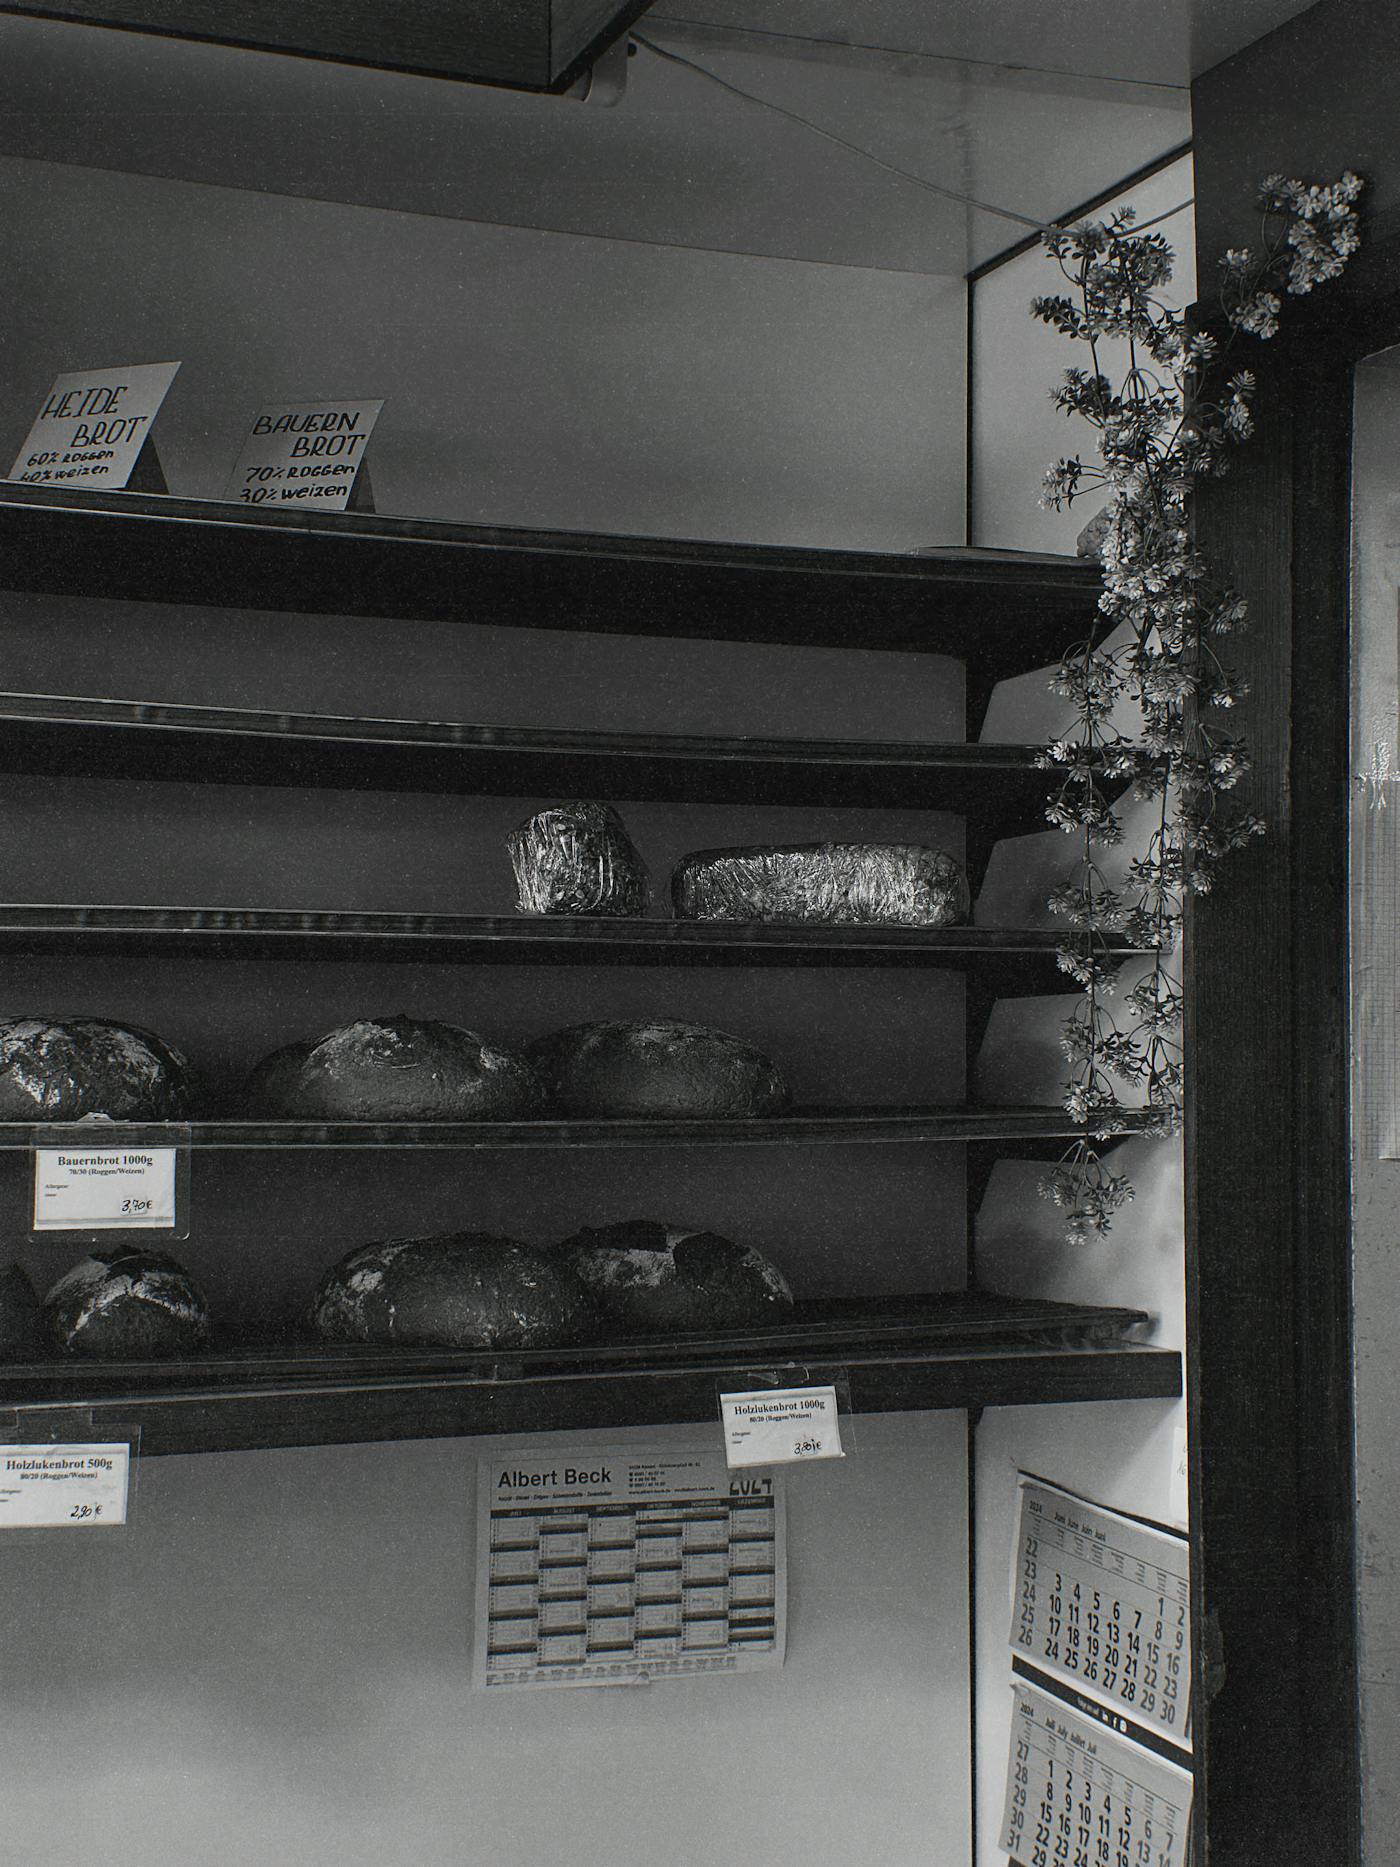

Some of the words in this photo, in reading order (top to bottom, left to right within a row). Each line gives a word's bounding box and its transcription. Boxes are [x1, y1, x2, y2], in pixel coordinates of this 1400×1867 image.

[41, 386, 128, 420] HEIDE
[70, 416, 149, 448] BROT
[252, 412, 360, 435] BAUERN
[290, 434, 366, 458] BROT
[27, 452, 59, 467] 60%
[246, 466, 285, 483] 70%
[240, 487, 277, 503] 30%
[58, 1155, 119, 1166] Bauernbrot
[123, 1155, 153, 1167] 1000g
[88, 1167, 145, 1176] (Roggen/Weizen)
[734, 1401, 797, 1415] Holzlukenbrot
[800, 1399, 825, 1410] 1000g
[6, 1459, 84, 1470] Holzlukenbrot
[87, 1458, 113, 1470] 500g
[40, 1472, 98, 1480] (Roggen/Weizen)
[498, 1470, 557, 1488] Albert
[565, 1467, 611, 1485] Beck
[1026, 1537, 1037, 1558] 22
[1158, 1597, 1164, 1616] 1
[1178, 1607, 1184, 1626] 2
[1025, 1560, 1036, 1579] 23
[1056, 1573, 1061, 1592] 3
[1074, 1584, 1080, 1602] 4
[1094, 1592, 1100, 1610] 5
[1113, 1601, 1120, 1620] 6
[1134, 1610, 1142, 1629] 7
[1155, 1621, 1162, 1640] 8
[1175, 1631, 1183, 1650] 9
[1024, 1581, 1036, 1602] 24
[1049, 1594, 1061, 1614] 10
[1069, 1603, 1079, 1624] 11
[1088, 1613, 1099, 1634] 12
[1107, 1622, 1120, 1643] 13
[1128, 1632, 1140, 1654] 14
[1147, 1642, 1160, 1664] 15
[1167, 1653, 1180, 1675] 16
[1022, 1603, 1034, 1624] 25
[1049, 1616, 1060, 1636] 17
[1068, 1626, 1079, 1647] 18
[1087, 1636, 1099, 1657] 19
[1105, 1644, 1119, 1667] 20
[1124, 1654, 1137, 1678] 21
[1144, 1665, 1157, 1689] 22
[1163, 1676, 1177, 1699] 23
[1019, 1625, 1032, 1646] 26
[1045, 1638, 1058, 1660] 24
[1064, 1648, 1078, 1669] 25
[1084, 1658, 1097, 1680] 26
[1103, 1668, 1116, 1690] 27
[1121, 1678, 1136, 1701] 28
[1140, 1689, 1155, 1712] 29
[1160, 1700, 1175, 1724] 30
[1017, 1740, 1029, 1761] 27
[1049, 1760, 1053, 1778] 1
[1066, 1770, 1072, 1790] 2
[1085, 1782, 1092, 1801] 3
[1104, 1795, 1111, 1814] 4
[1124, 1806, 1131, 1826] 5
[1145, 1820, 1152, 1839] 6
[1166, 1832, 1173, 1851] 7
[1014, 1784, 1026, 1807] 29
[1041, 1802, 1052, 1823] 15
[1059, 1814, 1071, 1835] 16
[1078, 1825, 1090, 1848] 17
[1097, 1838, 1109, 1861] 18
[1015, 1762, 1028, 1784] 28
[1047, 1782, 1053, 1800] 8
[1066, 1793, 1072, 1812] 9
[1079, 1802, 1091, 1824] 10
[1099, 1815, 1109, 1838] 11
[1119, 1828, 1130, 1851] 12
[1138, 1840, 1150, 1863] 13
[1007, 1829, 1020, 1852] 31
[1011, 1806, 1024, 1829] 30
[1036, 1823, 1050, 1847] 22
[1055, 1834, 1069, 1858] 23
